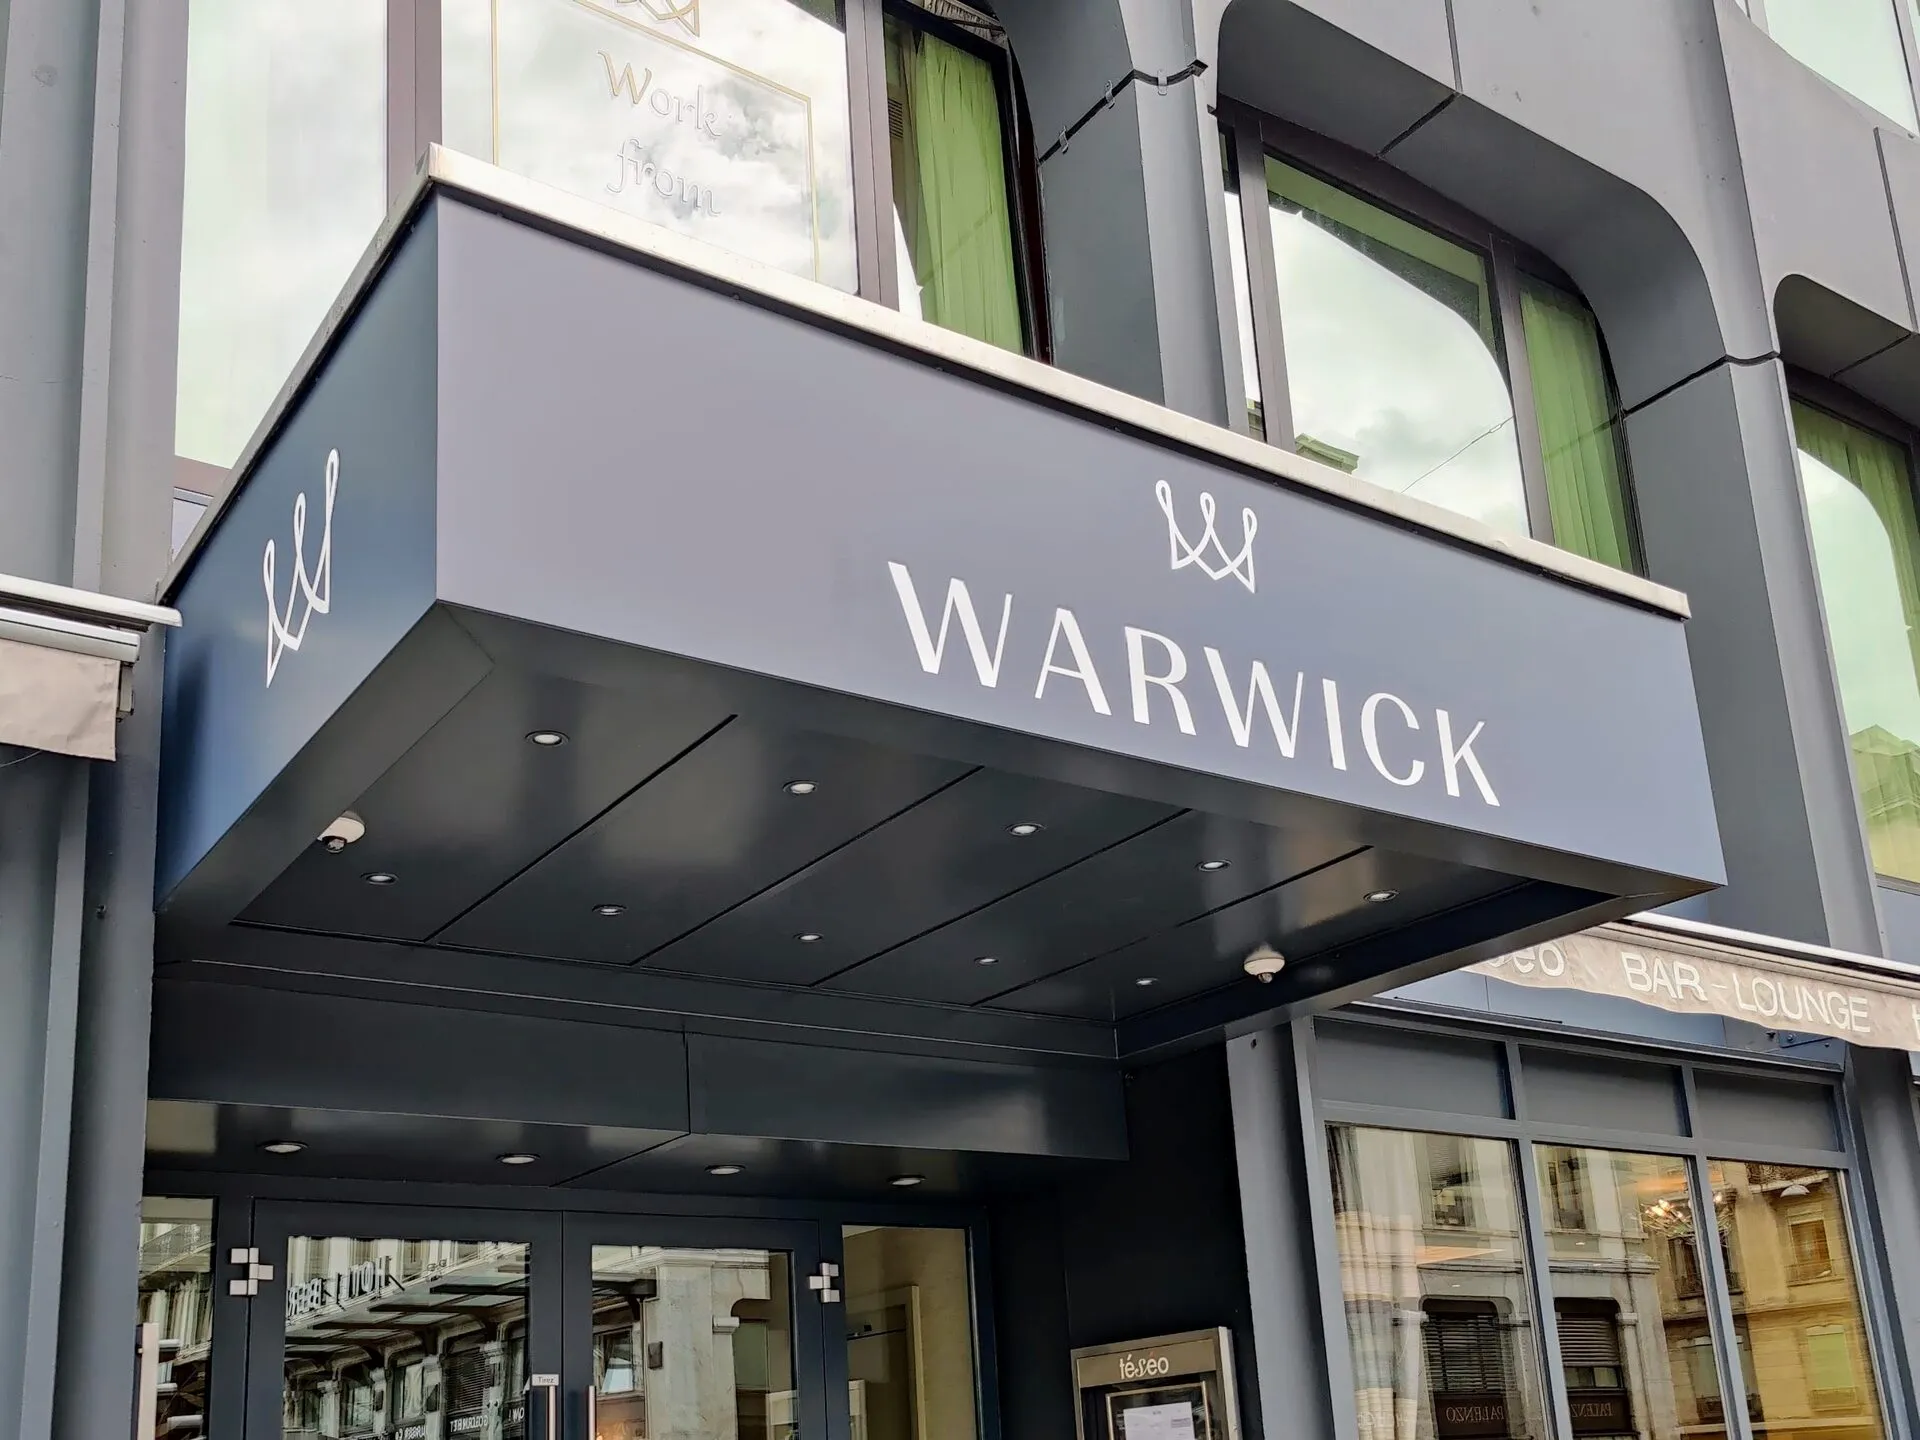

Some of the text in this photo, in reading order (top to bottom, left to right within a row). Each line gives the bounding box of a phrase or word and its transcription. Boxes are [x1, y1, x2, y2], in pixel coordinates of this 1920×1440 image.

[597, 49, 723, 139] Work
[605, 137, 723, 217] from
[887, 560, 1500, 807] WARWICK
